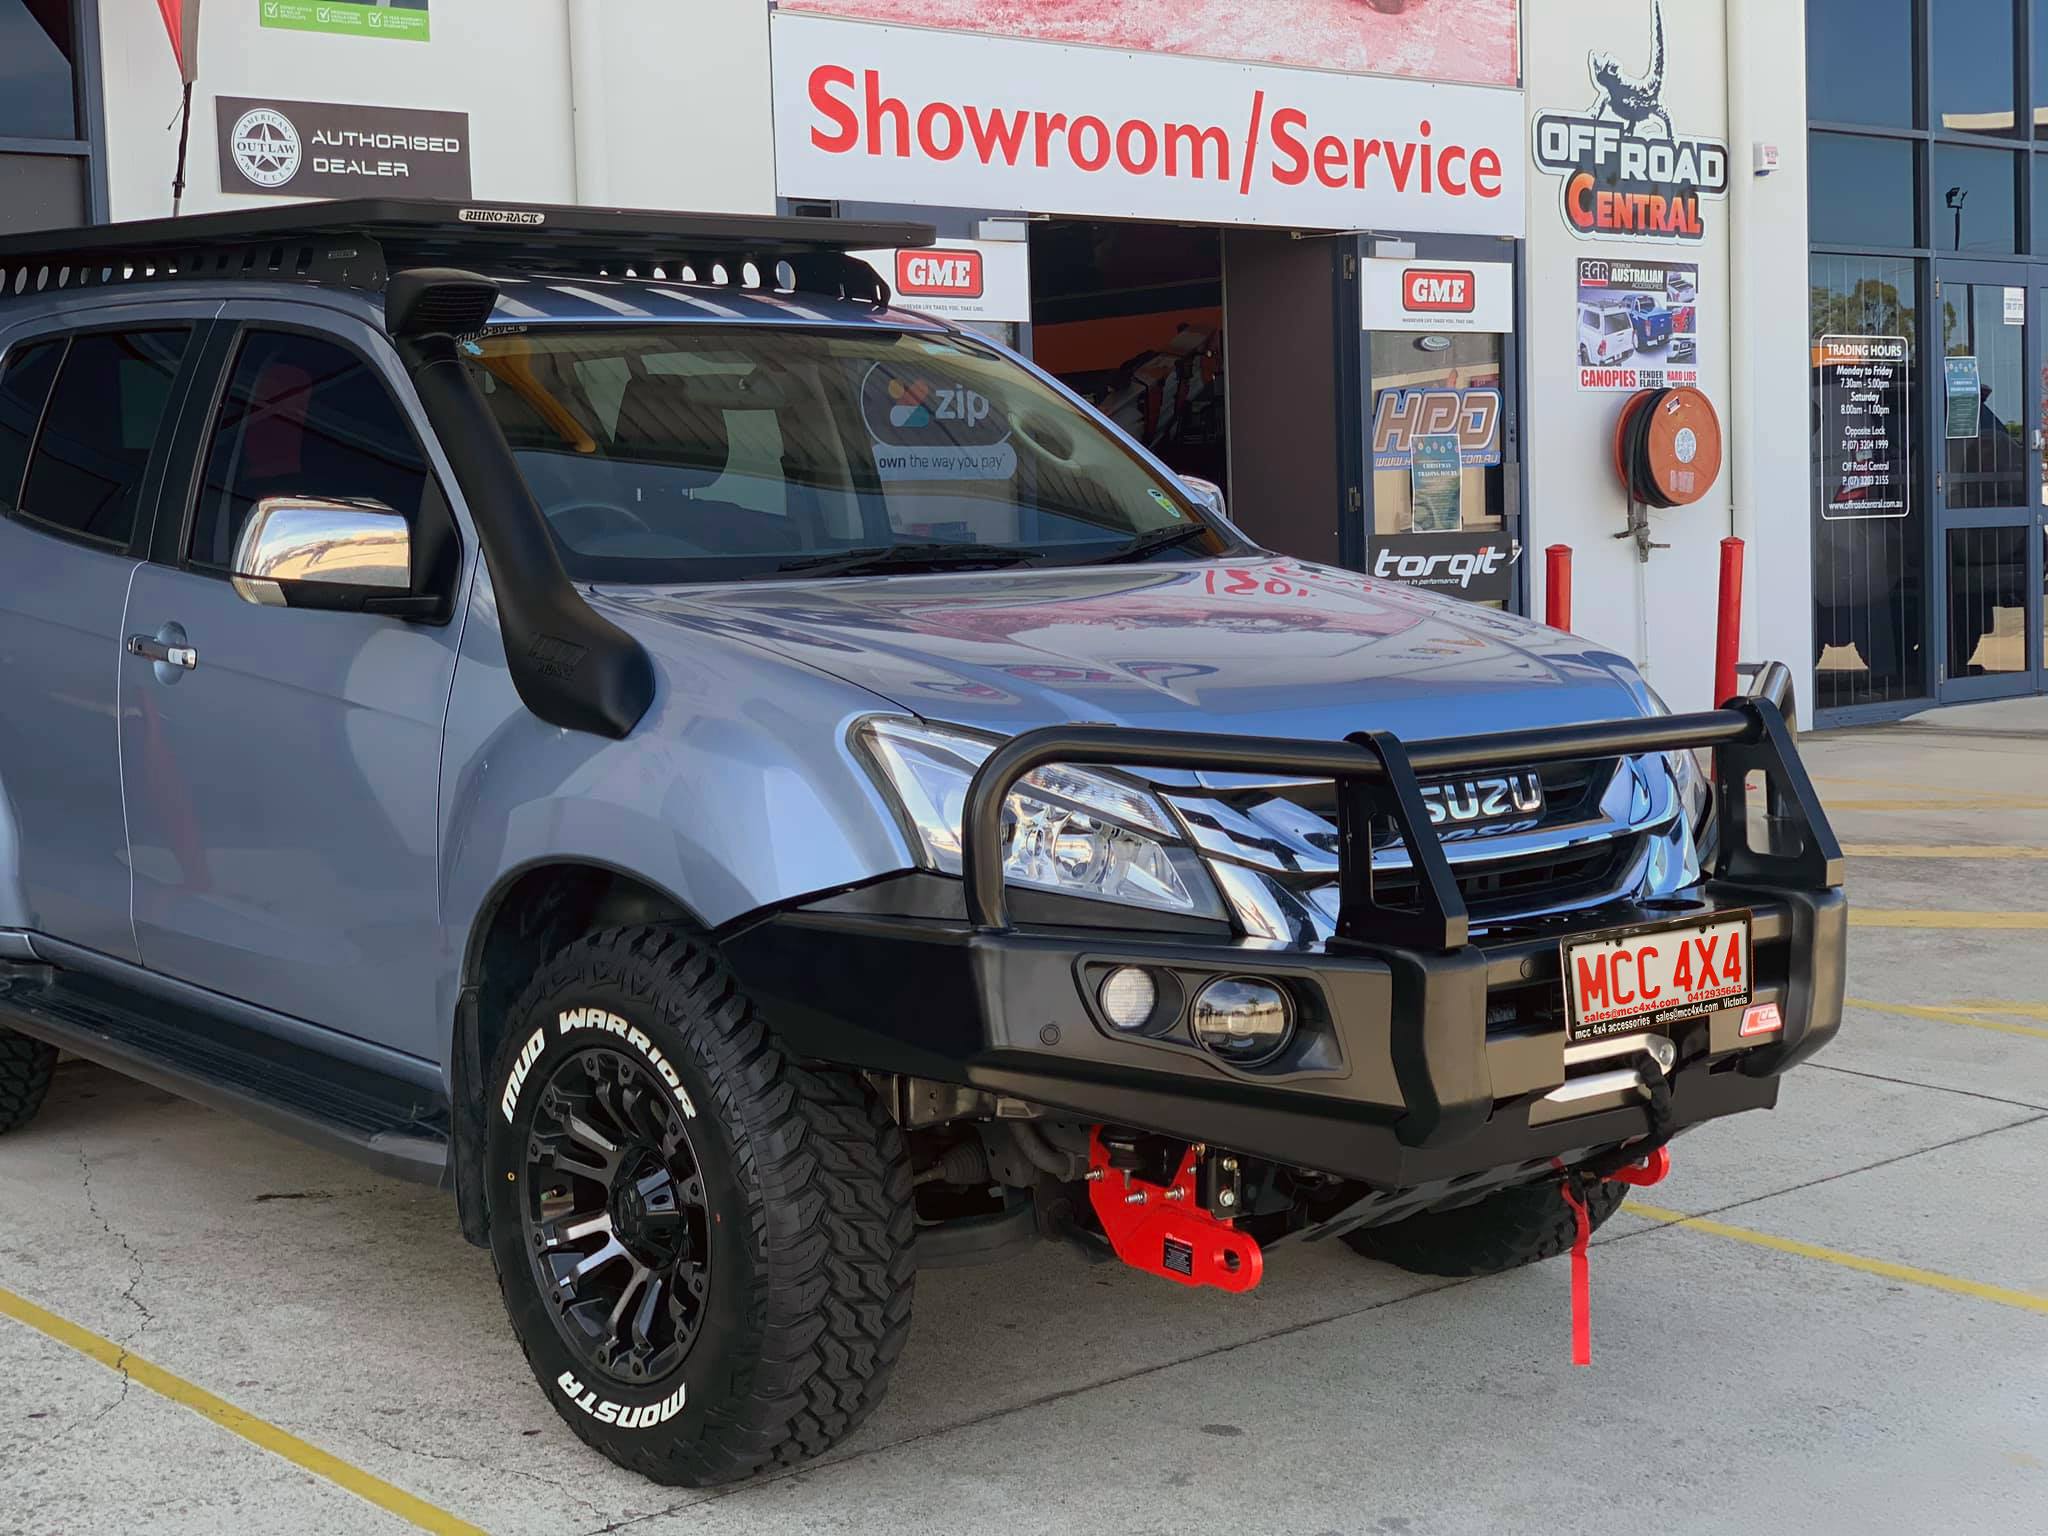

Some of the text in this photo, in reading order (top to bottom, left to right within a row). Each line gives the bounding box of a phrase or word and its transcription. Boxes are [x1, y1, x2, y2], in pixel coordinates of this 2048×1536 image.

[241, 114, 290, 135] AMERICAN
[237, 141, 296, 155] OUTLAW
[311, 130, 460, 153] AUTHORISED
[244, 161, 292, 184] WHEELS
[313, 158, 410, 177] DEALER
[1568, 172, 1702, 235] CENTRAL
[465, 210, 539, 223] RHINO-RACK
[907, 257, 970, 287] GME
[1580, 261, 1609, 281] EGR
[1611, 267, 1664, 283] AUSTRALIAN
[1411, 277, 1465, 303] GME
[1827, 344, 1902, 357] TRADING HOURS
[1581, 369, 1637, 388] CANOPIES
[1639, 370, 1664, 379] FENDER
[1667, 370, 1697, 381] HARD LIDS
[1836, 365, 1893, 379] Monday to Friday
[1639, 379, 1664, 388] FLARES
[1840, 378, 1862, 389] 7.30am
[935, 384, 990, 428] zip
[1850, 391, 1880, 404] Saturday
[1373, 391, 1500, 451] HPD
[1844, 425, 1886, 437] Opposite Lock
[1860, 440, 1874, 450] 3204
[1875, 440, 1889, 450] 1999
[879, 457, 906, 468] own
[910, 455, 929, 468] the
[932, 458, 957, 471] way
[958, 458, 979, 471] you
[1853, 461, 1868, 471] Road
[1868, 461, 1890, 471] Central
[1374, 546, 1506, 589] torqit
[1420, 773, 1543, 823] SUZU
[1577, 931, 1742, 1013] MCC 4X4
[1583, 984, 1742, 1023] sales@mcc4x4.com 0412935643
[1575, 994, 1748, 1040] mcc 4x4 accessories sales@mcc4x4.com Victoria
[501, 1007, 697, 1125] MUD WARRIOR
[557, 1370, 687, 1429] MONSTA
